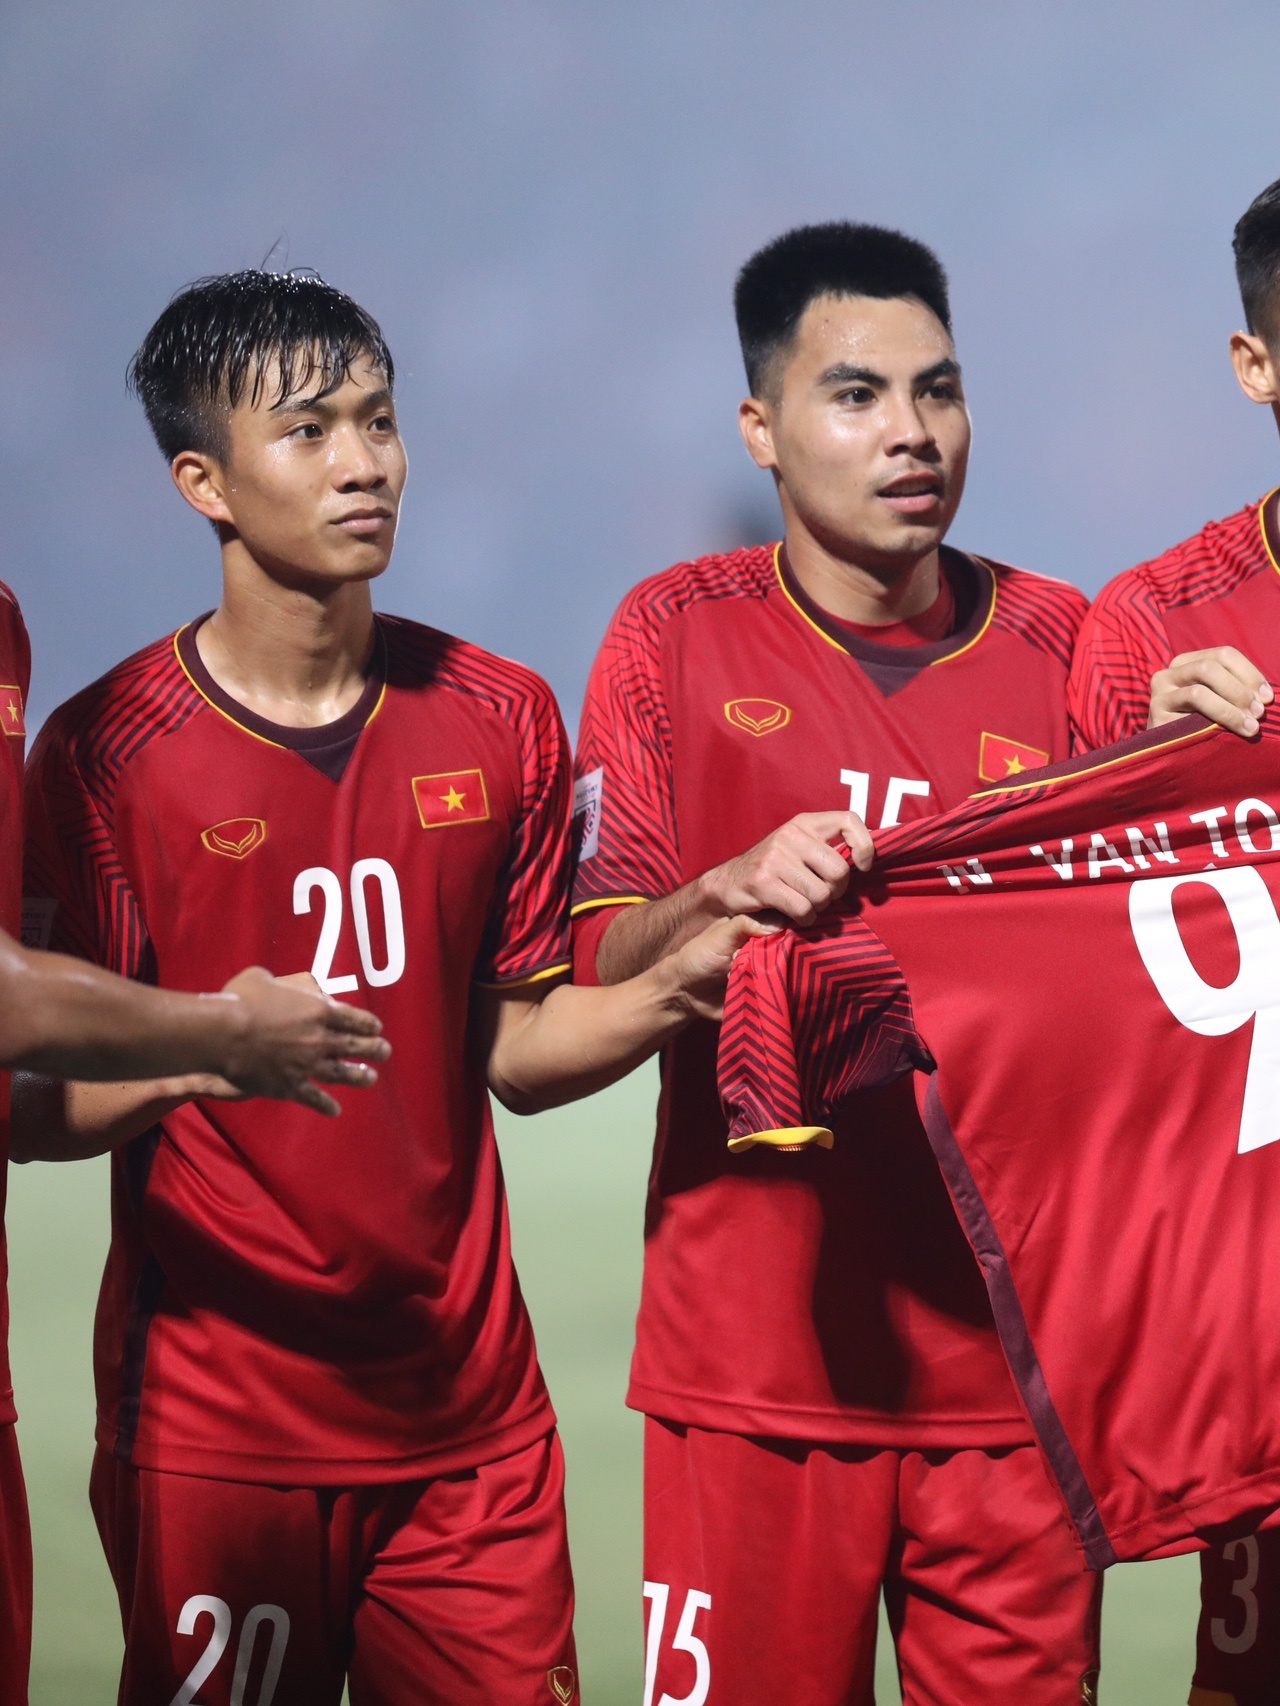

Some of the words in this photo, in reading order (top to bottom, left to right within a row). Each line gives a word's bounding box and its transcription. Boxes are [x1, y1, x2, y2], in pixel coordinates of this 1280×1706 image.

[1029, 821, 1180, 880] VAN
[292, 857, 406, 995] 20
[169, 1594, 291, 1706] 20
[642, 1580, 712, 1706] 15
[1210, 1534, 1260, 1655] 3
